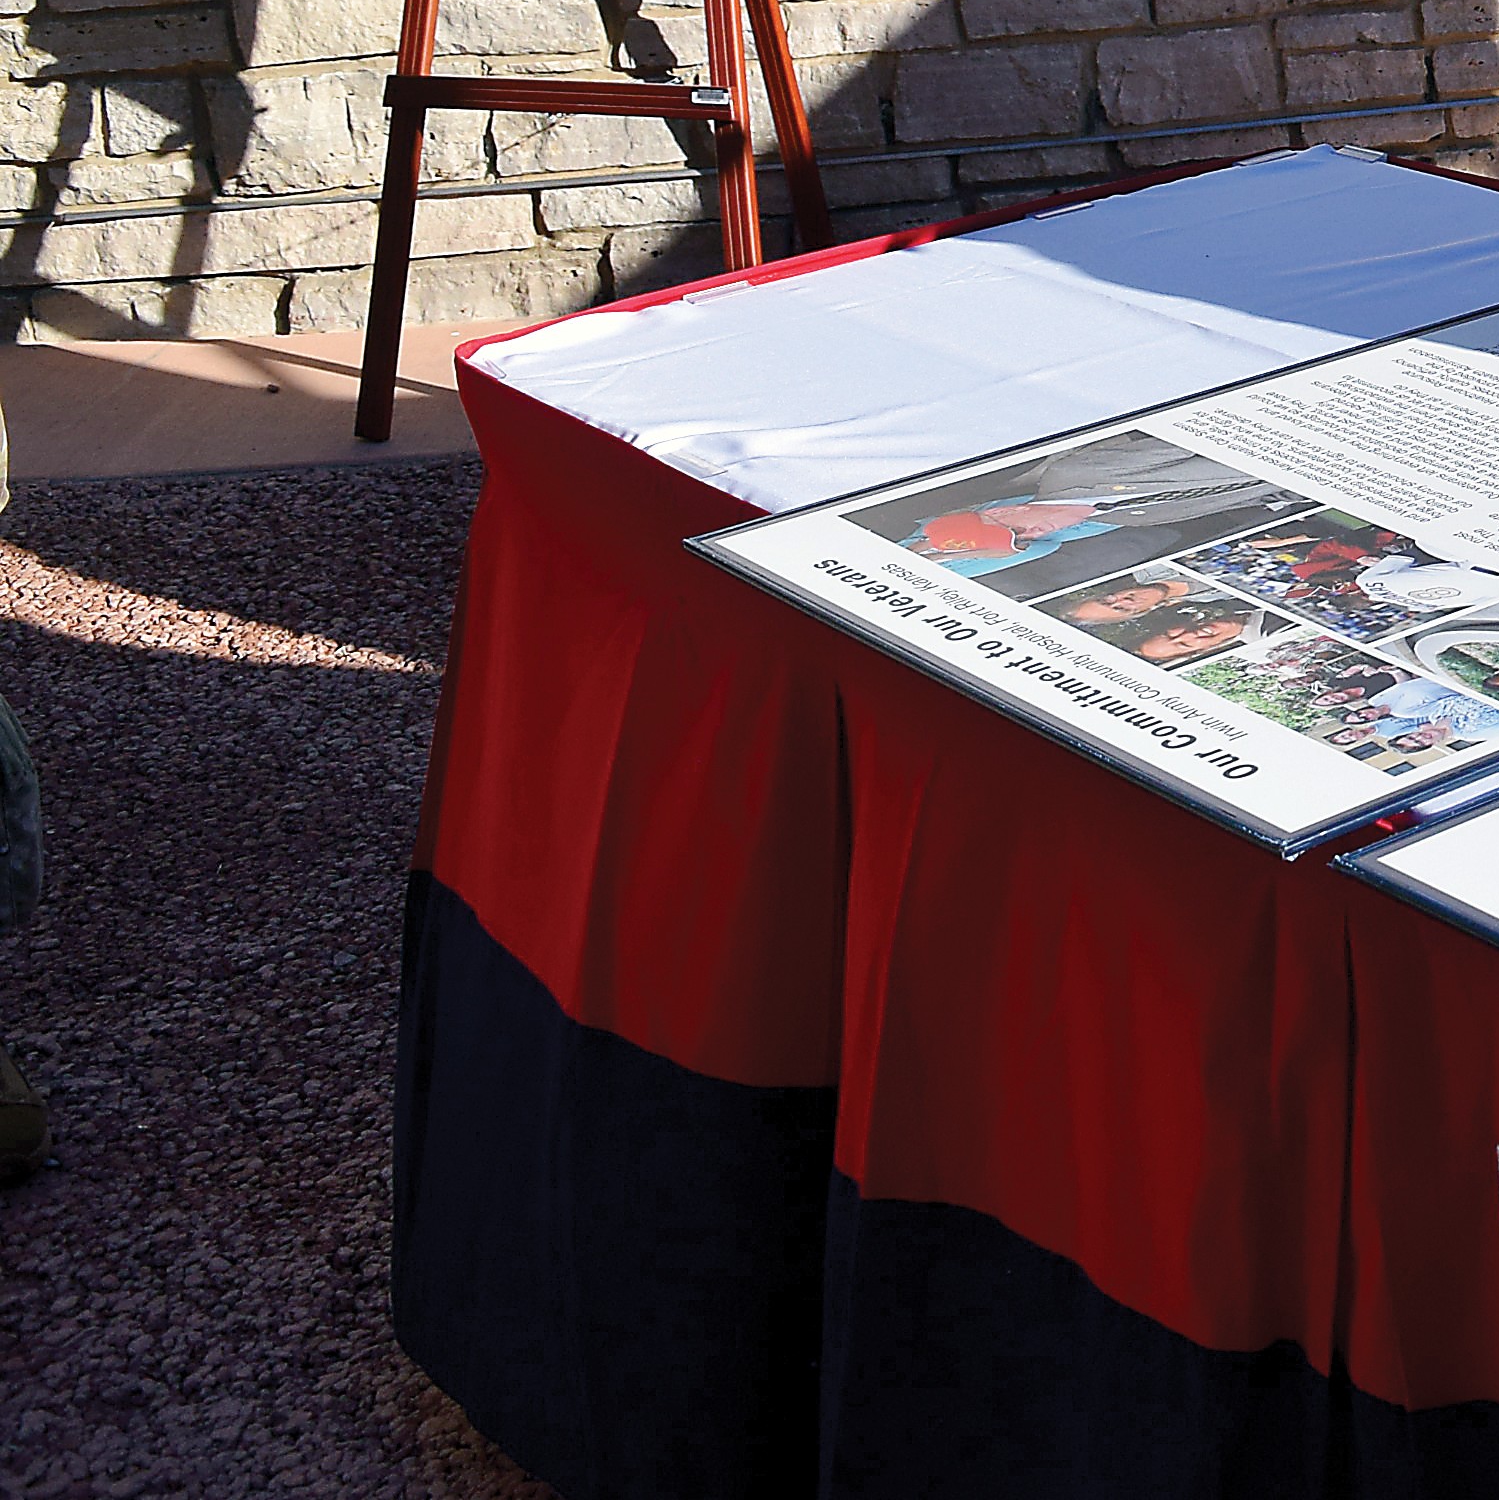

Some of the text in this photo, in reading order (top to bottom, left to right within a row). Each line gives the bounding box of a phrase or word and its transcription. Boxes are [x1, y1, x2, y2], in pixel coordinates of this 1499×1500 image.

[1452, 530, 1485, 544] most
[811, 557, 1260, 780] Our Commitment to Our Veterans
[880, 562, 1248, 742] Irwin Army Community Hospital, Fort Riley, Kansas
